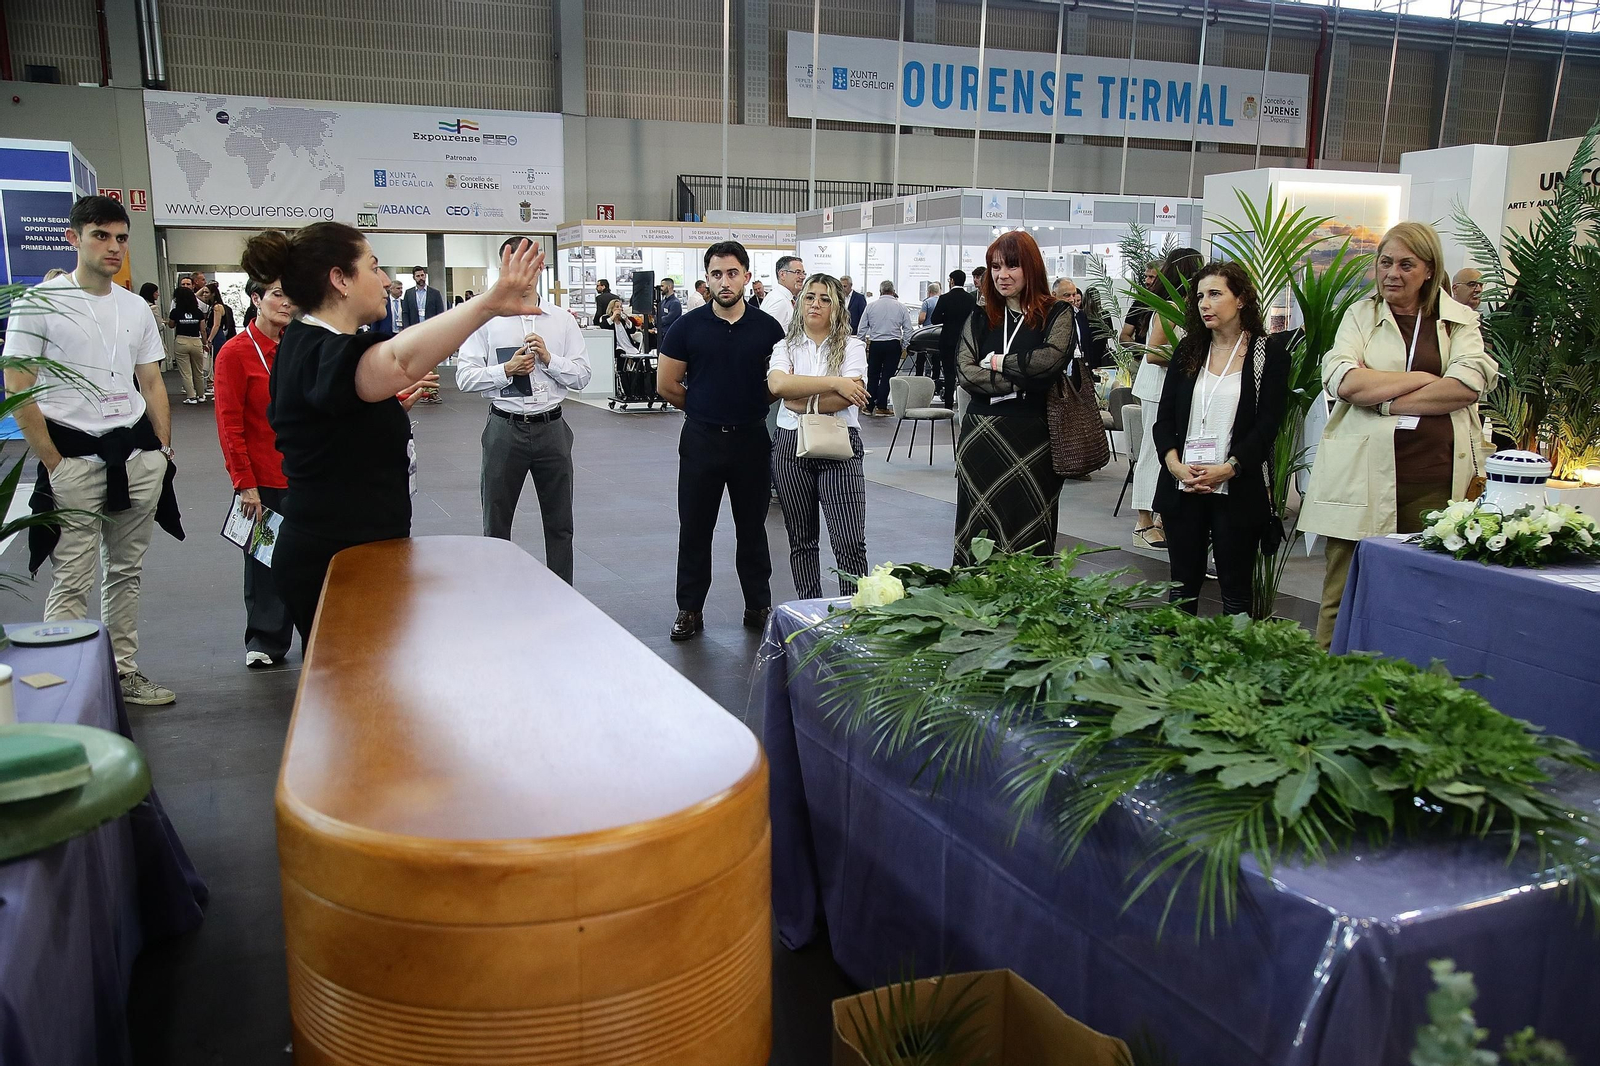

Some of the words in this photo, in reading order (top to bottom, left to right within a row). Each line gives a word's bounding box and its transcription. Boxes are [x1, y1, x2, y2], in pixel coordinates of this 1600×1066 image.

[850, 70, 878, 79] XUNTA
[850, 79, 860, 88] DE
[861, 80, 895, 90] GALICIA
[903, 60, 1084, 117] OURENSE
[1097, 75, 1234, 127] TERMAL
[413, 132, 480, 143] Expourense
[445, 154, 477, 162] Patronato
[389, 171, 417, 179] XUNTA
[460, 174, 485, 182] Concello
[460, 182, 500, 190] OURENSE
[1507, 201, 1527, 209] ARTE
[1529, 200, 1535, 208] Y
[165, 203, 335, 221] www.expourense.org
[446, 206, 470, 216] CEO
